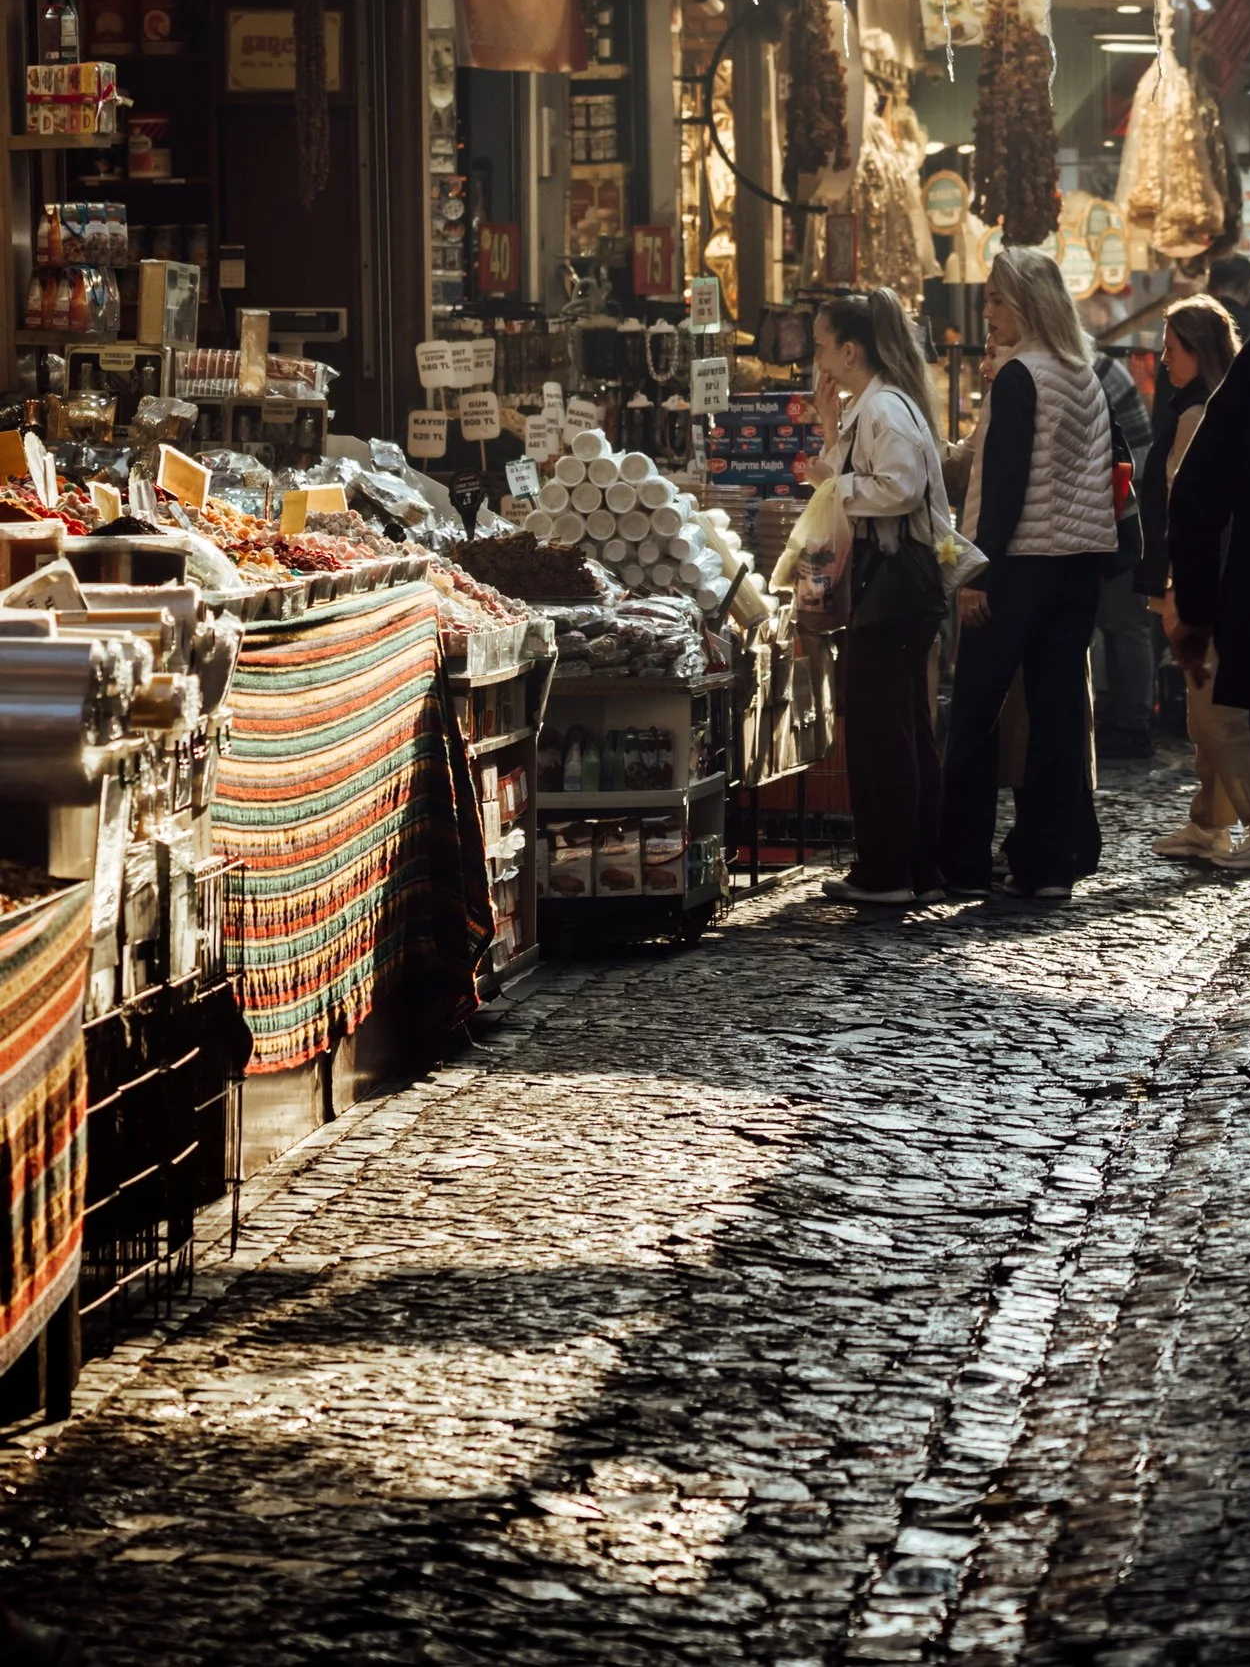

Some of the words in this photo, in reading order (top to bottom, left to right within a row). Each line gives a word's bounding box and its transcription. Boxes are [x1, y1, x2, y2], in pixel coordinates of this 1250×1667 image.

[490, 233, 510, 282] 40
[440, 362, 451, 370] TL
[484, 417, 496, 426] TL
[413, 432, 430, 441] 620
[433, 432, 444, 442] TL
